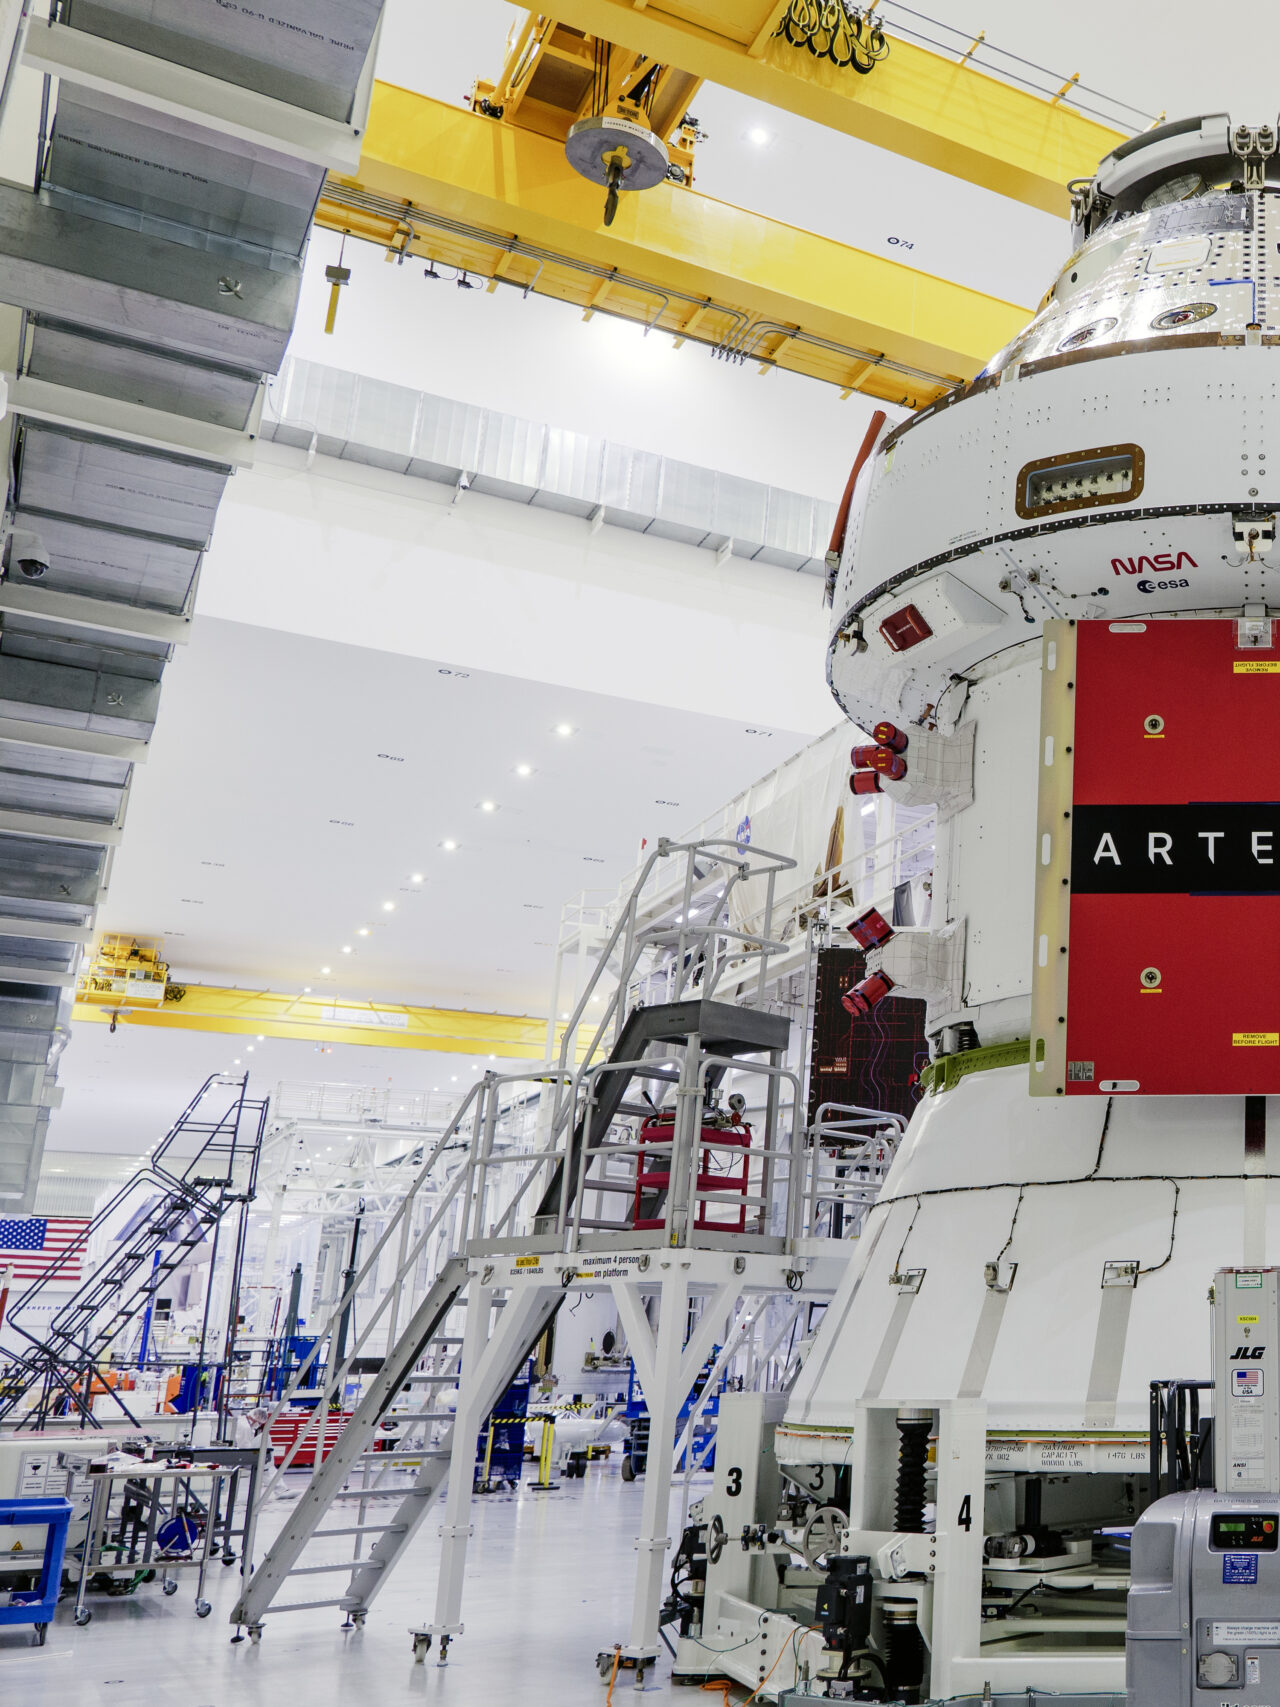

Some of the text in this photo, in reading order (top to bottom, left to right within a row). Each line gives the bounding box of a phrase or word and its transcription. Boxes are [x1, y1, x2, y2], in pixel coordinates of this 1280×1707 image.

[899, 238, 915, 251] 74
[1110, 552, 1199, 576] NASA
[1157, 578, 1190, 590] esa
[583, 1256, 612, 1266] maximum
[603, 1268, 628, 1279] platform
[1230, 1346, 1266, 1360] JLG
[726, 1467, 742, 1496] 3
[809, 1464, 824, 1491] 3
[958, 1494, 971, 1532] 4
